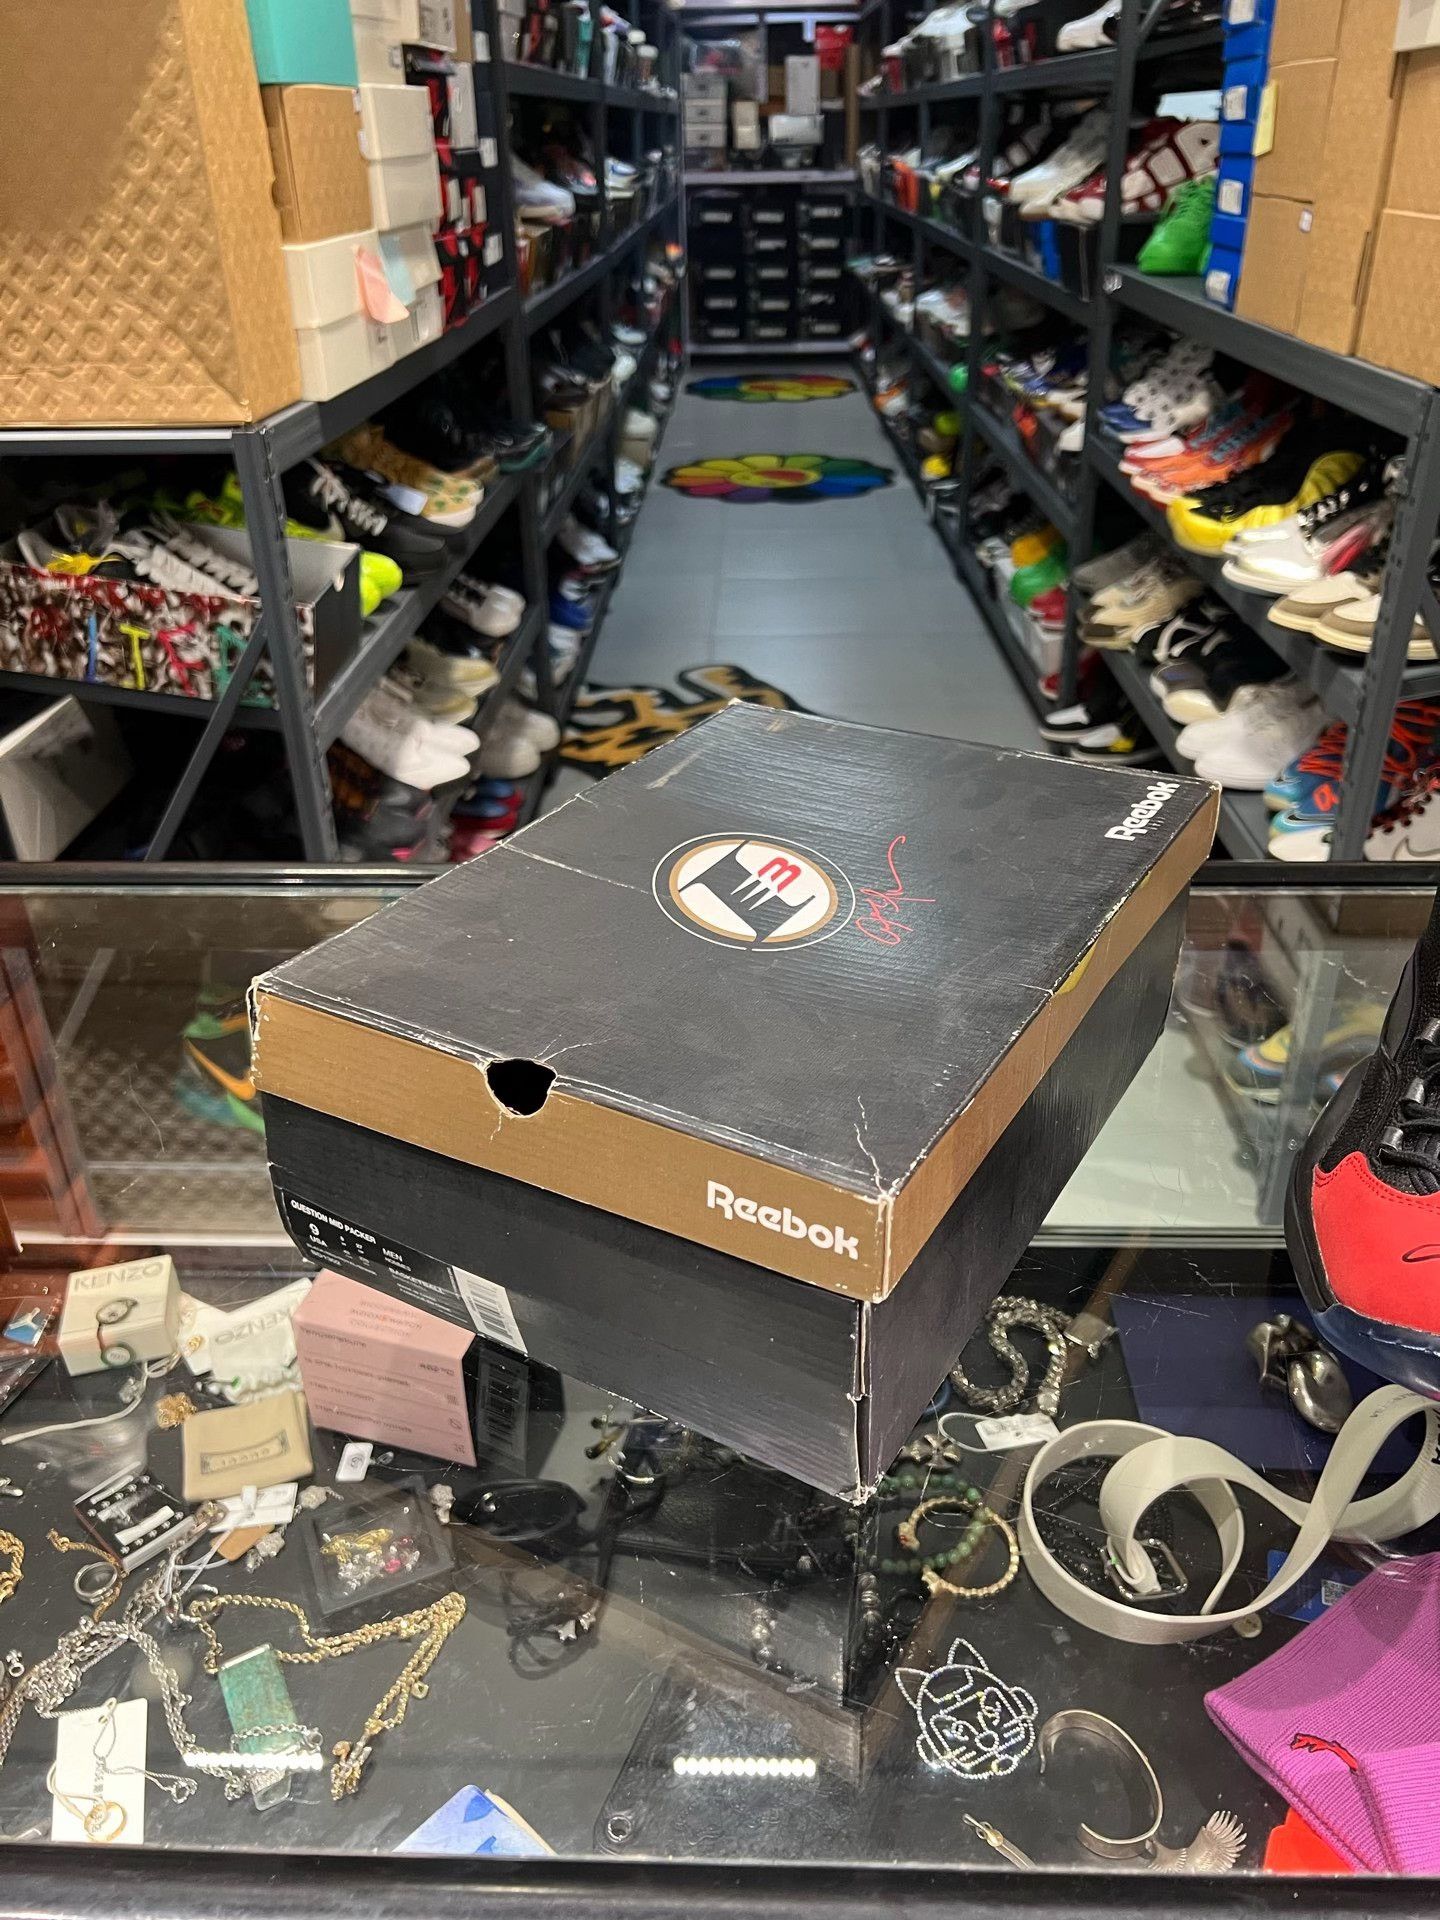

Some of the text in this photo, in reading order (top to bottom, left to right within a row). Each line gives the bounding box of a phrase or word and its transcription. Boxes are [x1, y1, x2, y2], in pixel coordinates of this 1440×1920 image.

[1104, 781, 1180, 841] Reebok
[290, 1199, 328, 1223] QUESTION
[328, 1217, 344, 1230] MID
[344, 1224, 377, 1245] PACKER
[309, 1223, 320, 1236] 9
[707, 1179, 859, 1260] Reebok
[309, 1234, 328, 1248] USA
[382, 1247, 403, 1262] MEN
[73, 1261, 164, 1292] KENZO
[388, 1267, 445, 1295] BASKETBALL
